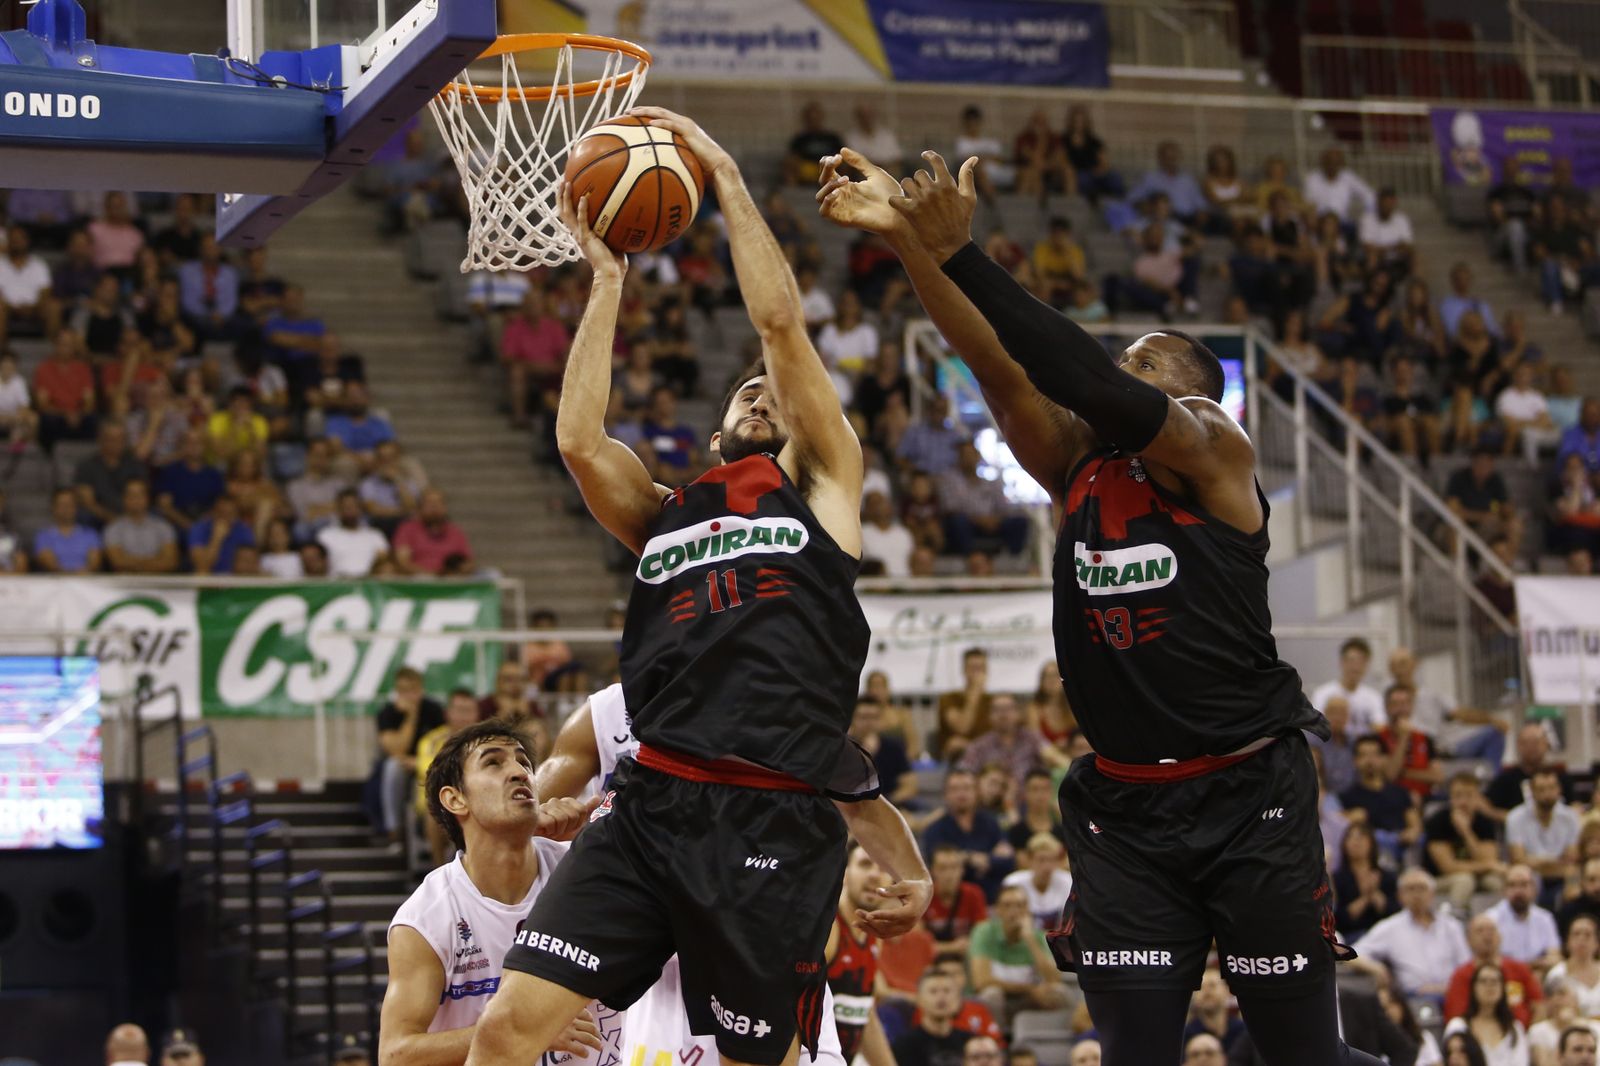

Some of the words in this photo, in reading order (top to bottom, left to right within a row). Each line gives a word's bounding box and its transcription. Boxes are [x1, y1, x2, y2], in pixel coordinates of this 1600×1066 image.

[4, 91, 101, 119] ONDO
[640, 521, 803, 580] COVIRAN
[705, 568, 743, 614] 11
[217, 594, 479, 707] CSIF
[744, 853, 779, 870] vive
[527, 931, 600, 972] BERNER
[1096, 950, 1173, 967] BERNER
